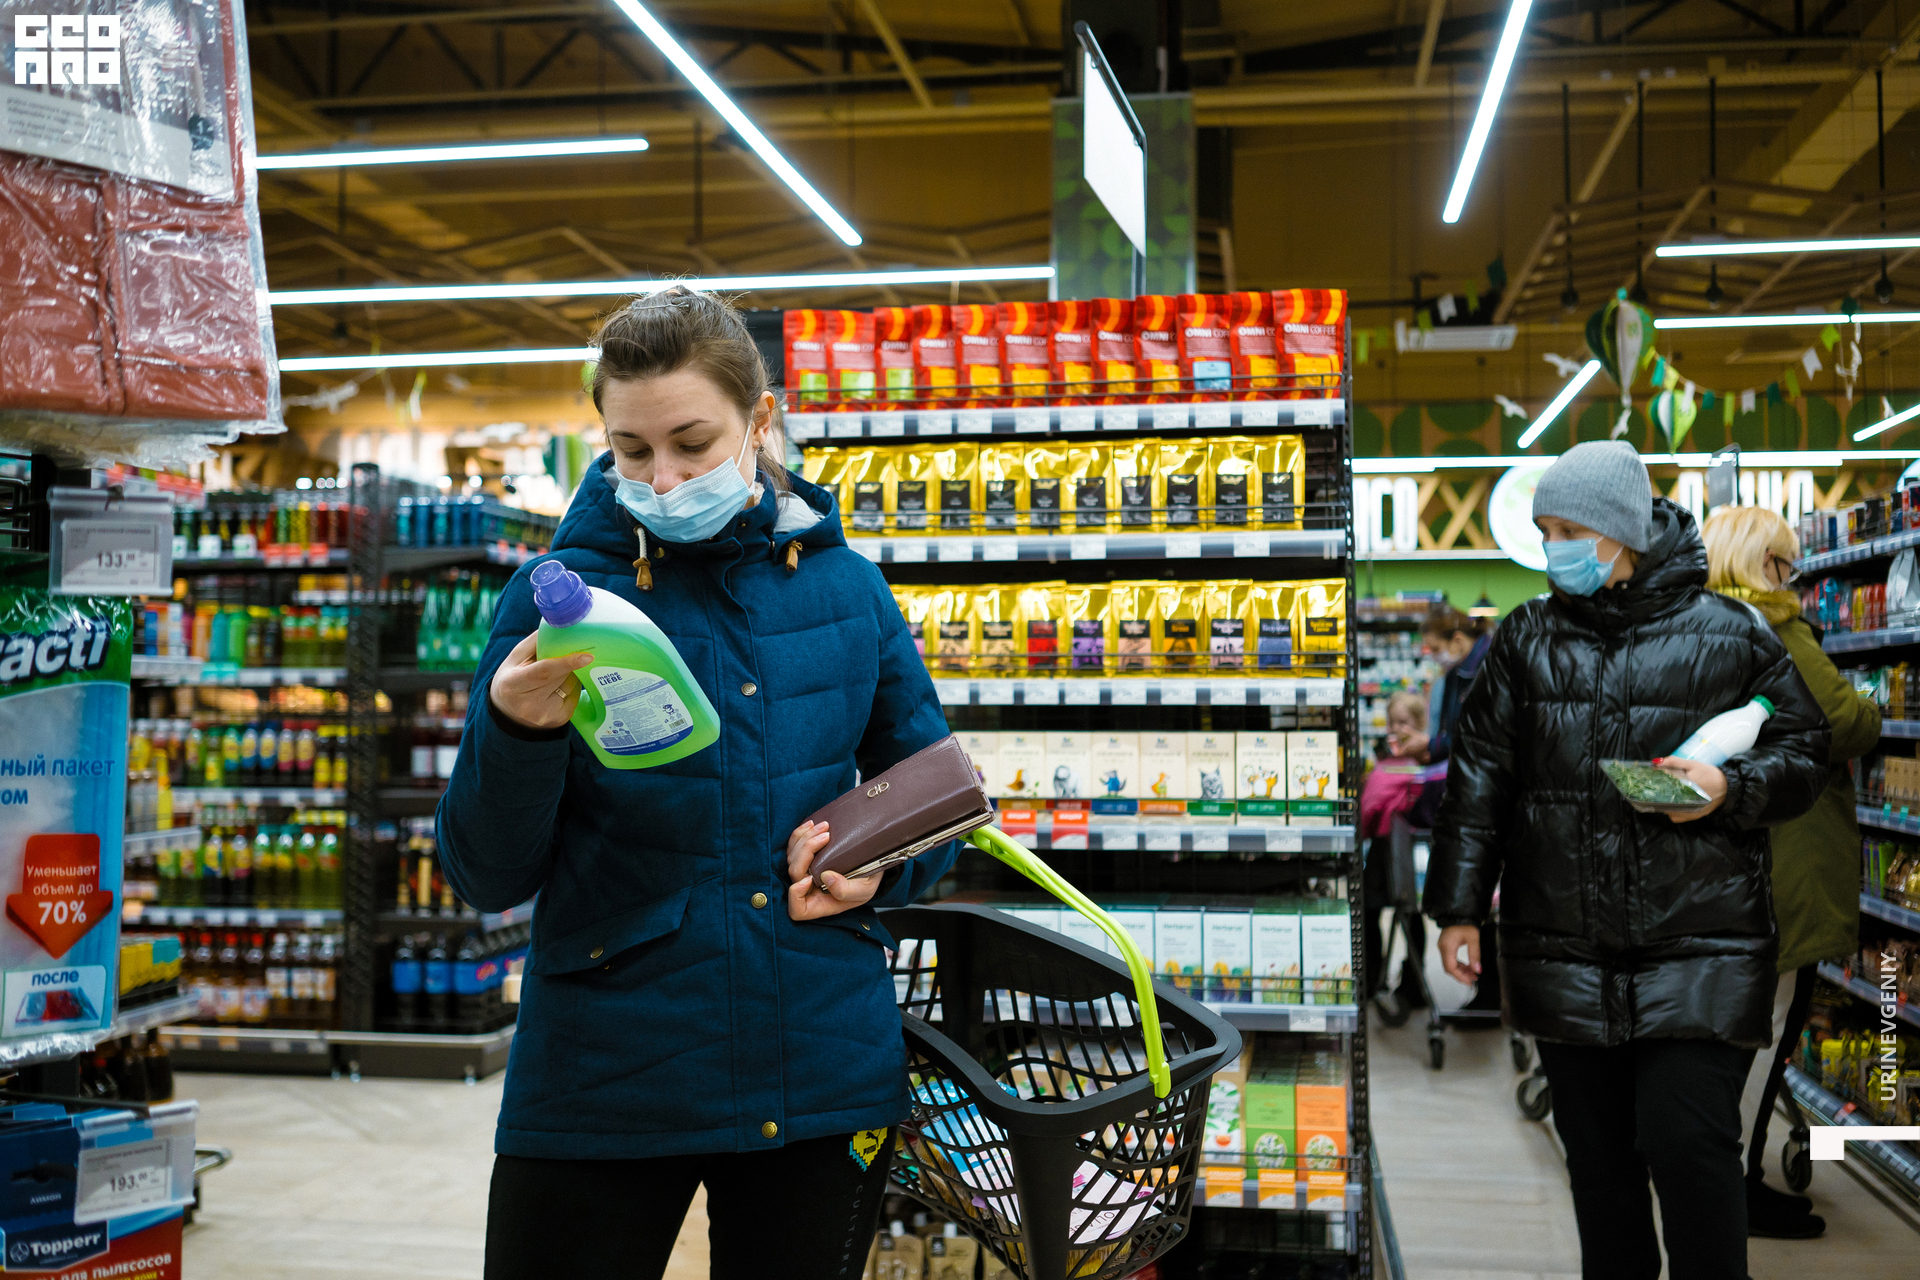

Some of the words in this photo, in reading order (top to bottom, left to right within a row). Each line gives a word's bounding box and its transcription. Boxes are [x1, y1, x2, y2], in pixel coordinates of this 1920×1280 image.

[1097, 330, 1123, 342] OMNI
[1185, 327, 1212, 337] OMNI
[1237, 326, 1265, 336] OMNI
[1283, 322, 1310, 334] OMNI
[1310, 324, 1337, 335] COFFEE
[1004, 334, 1033, 345] OMNI
[1054, 332, 1082, 343] OMNI
[0, 619, 109, 685] acti
[599, 675, 622, 686] LIEBE
[52, 758, 115, 777] пакет
[26, 864, 98, 879] Уменьшает
[33, 882, 75, 896] объем
[77, 882, 94, 897] до
[38, 900, 88, 926] 70%
[31, 968, 80, 988] после
[839, 1184, 864, 1276] CULTURE
[30, 1232, 102, 1257] Topperr
[92, 1253, 172, 1280] ПЫЛЕСОСОВ
